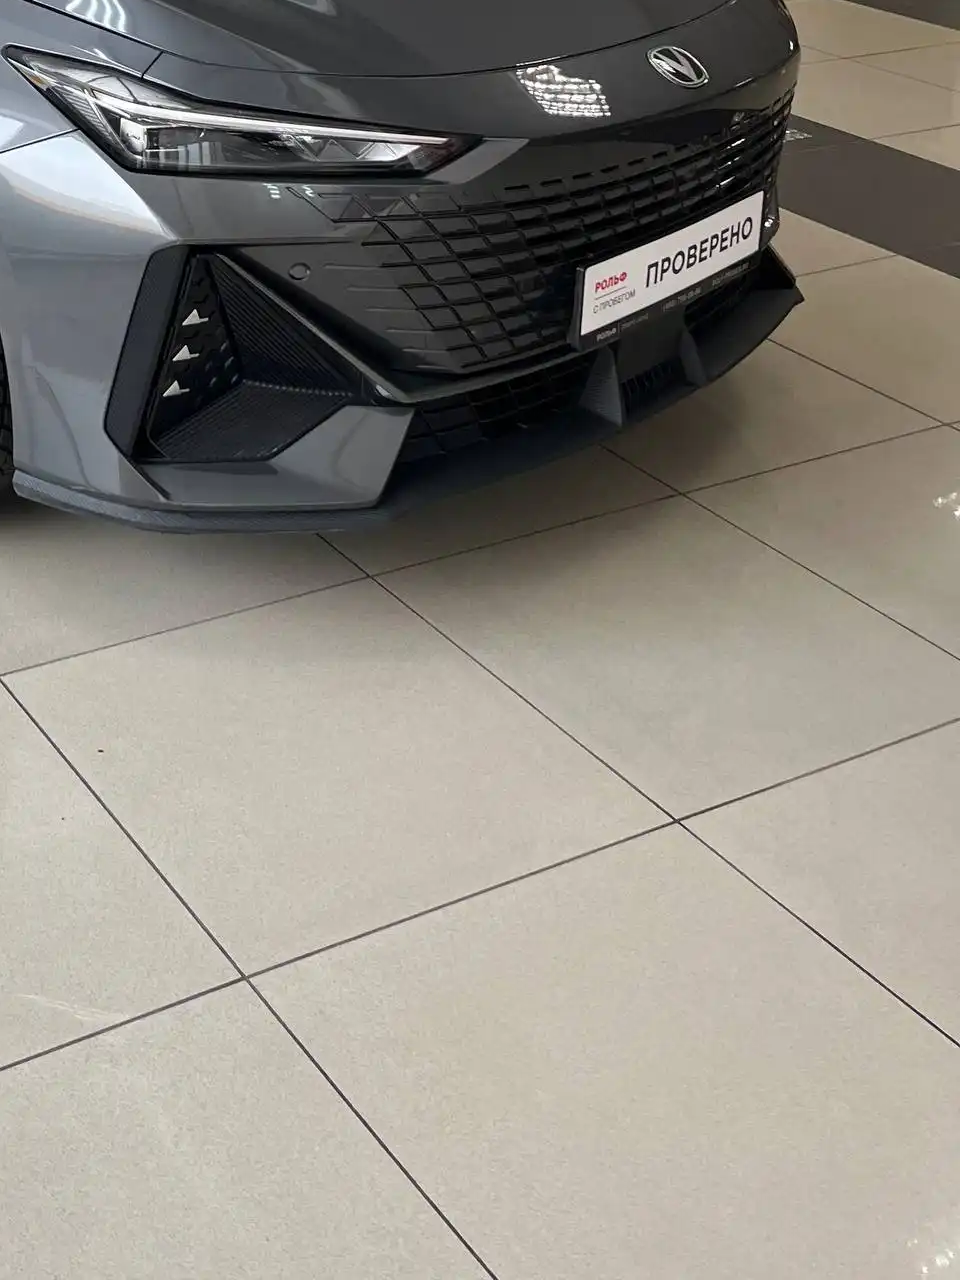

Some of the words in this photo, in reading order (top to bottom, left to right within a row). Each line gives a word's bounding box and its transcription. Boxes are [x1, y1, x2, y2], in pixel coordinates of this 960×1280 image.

[594, 271, 628, 294] РОЛЬФ
[645, 216, 754, 289] ПРОВЕРЕНО
[592, 305, 600, 314] С
[599, 288, 637, 312] ПРОБЕГОМ
